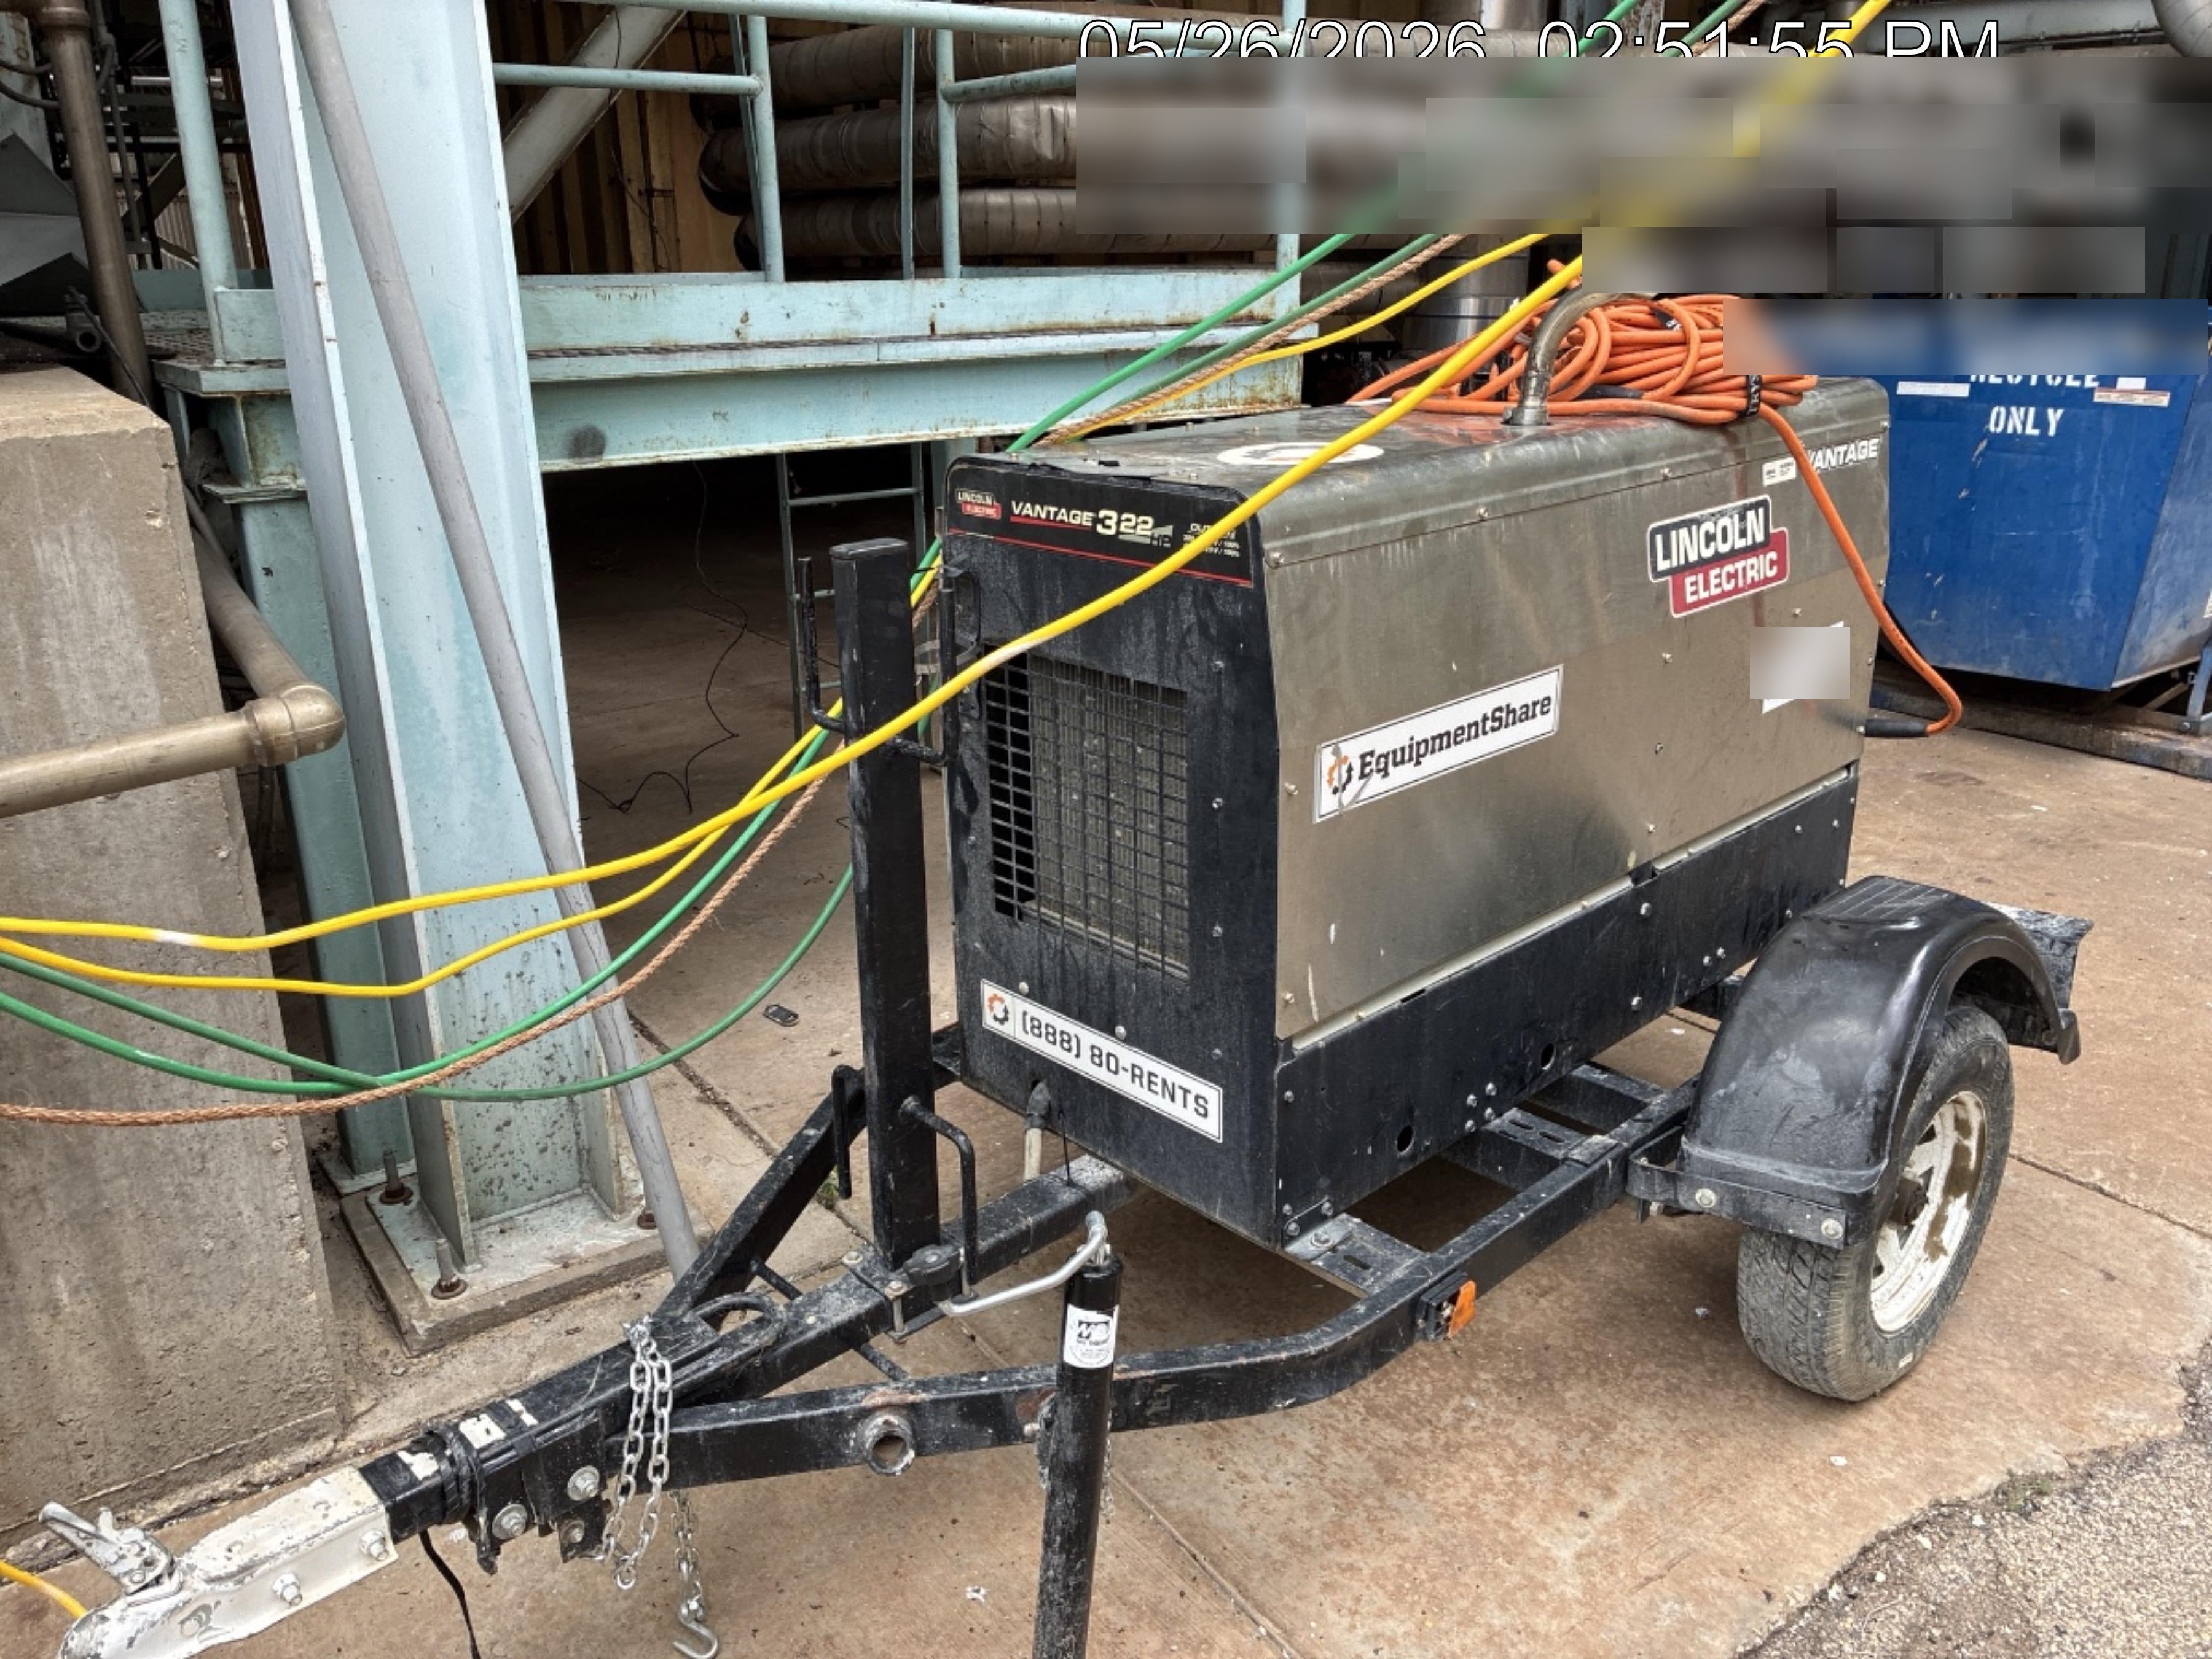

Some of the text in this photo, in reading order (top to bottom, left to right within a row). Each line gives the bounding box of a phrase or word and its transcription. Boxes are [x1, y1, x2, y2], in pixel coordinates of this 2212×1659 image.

[1988, 405, 2065, 437] ONLY
[1011, 500, 1155, 536] VANTAGE 322
[1655, 506, 1765, 572] LINCOLN
[1685, 551, 1778, 603] ELECTRIC
[1358, 696, 1551, 780] EquipmentShare
[1022, 1010, 1209, 1119] (888) 80-RENTS
